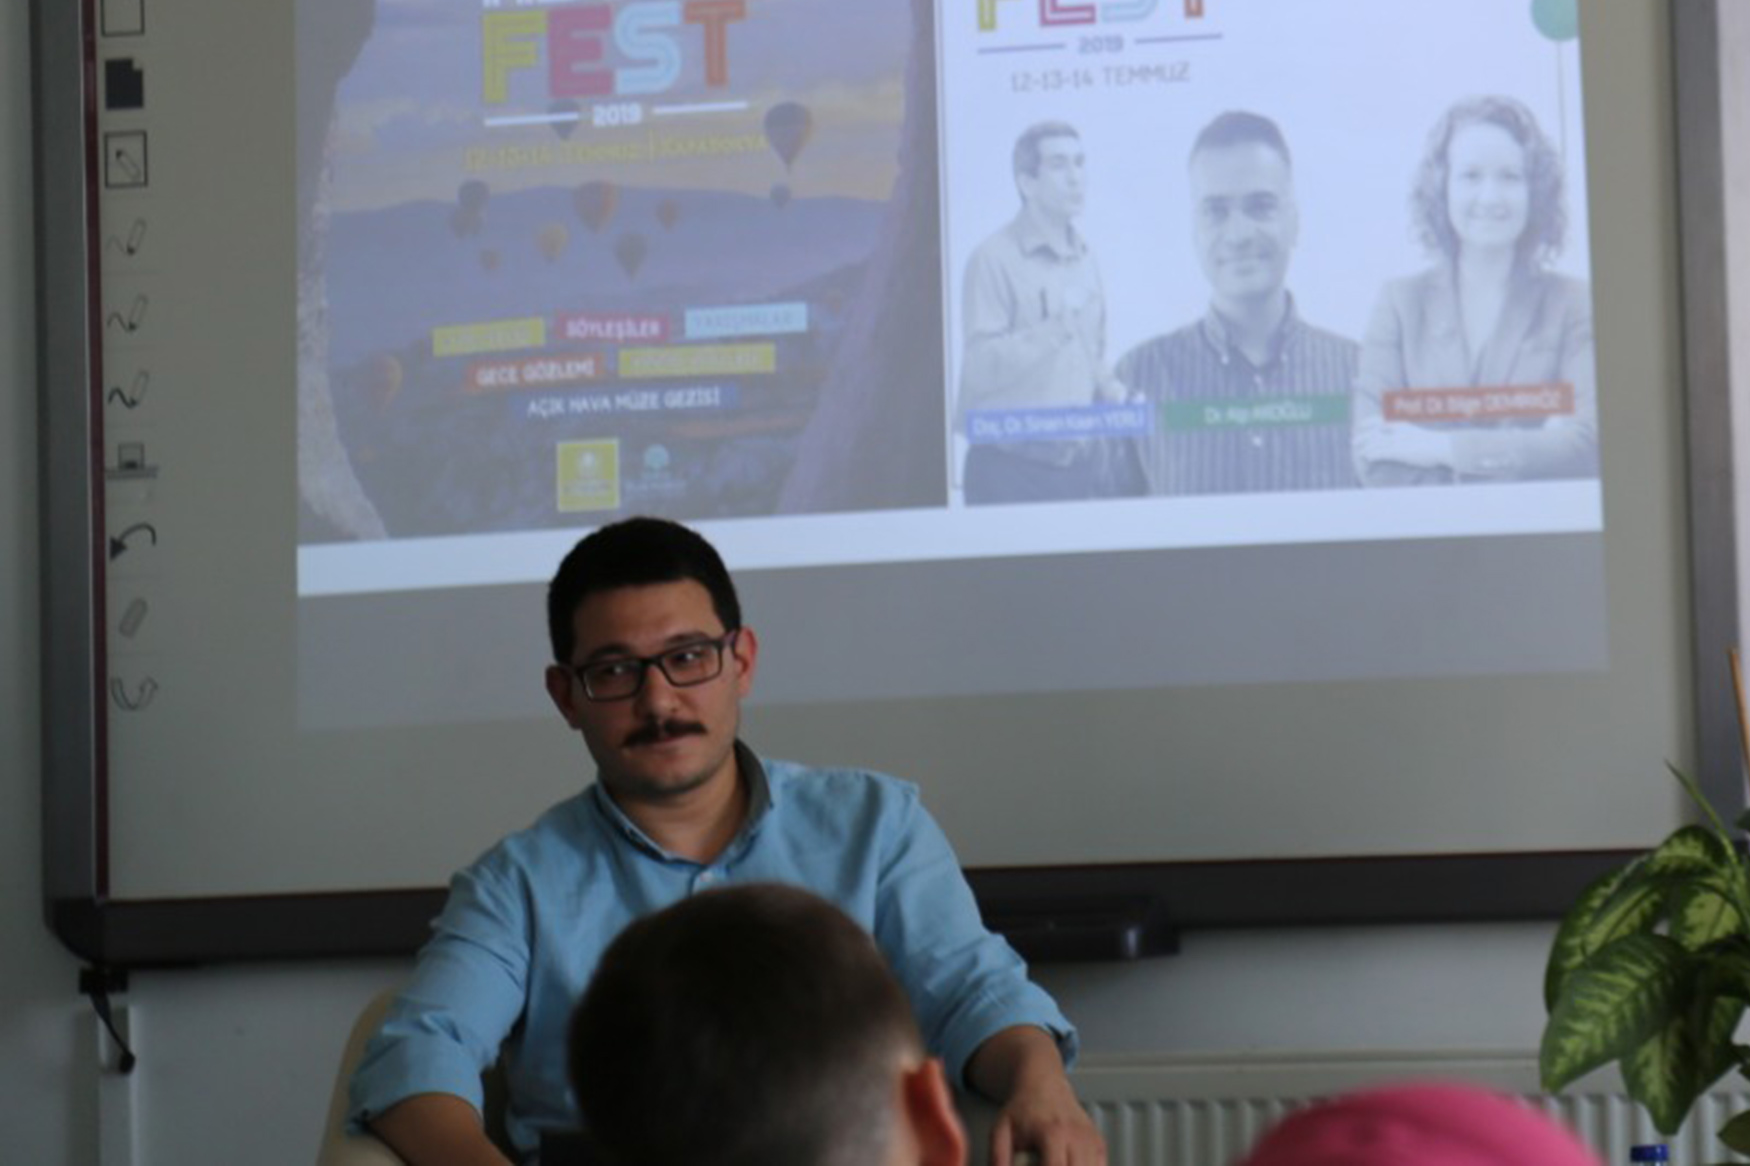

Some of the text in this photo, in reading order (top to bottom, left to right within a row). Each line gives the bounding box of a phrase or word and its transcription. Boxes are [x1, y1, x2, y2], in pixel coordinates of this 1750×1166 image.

[1078, 34, 1124, 55] 2019
[1010, 60, 1191, 93] 12-13-14 TEMMUZ
[592, 101, 643, 126] 2019
[475, 365, 519, 387] GECE
[526, 397, 564, 419] AÇIK
[569, 395, 612, 415] HAVA
[615, 388, 660, 411] MÜZE
